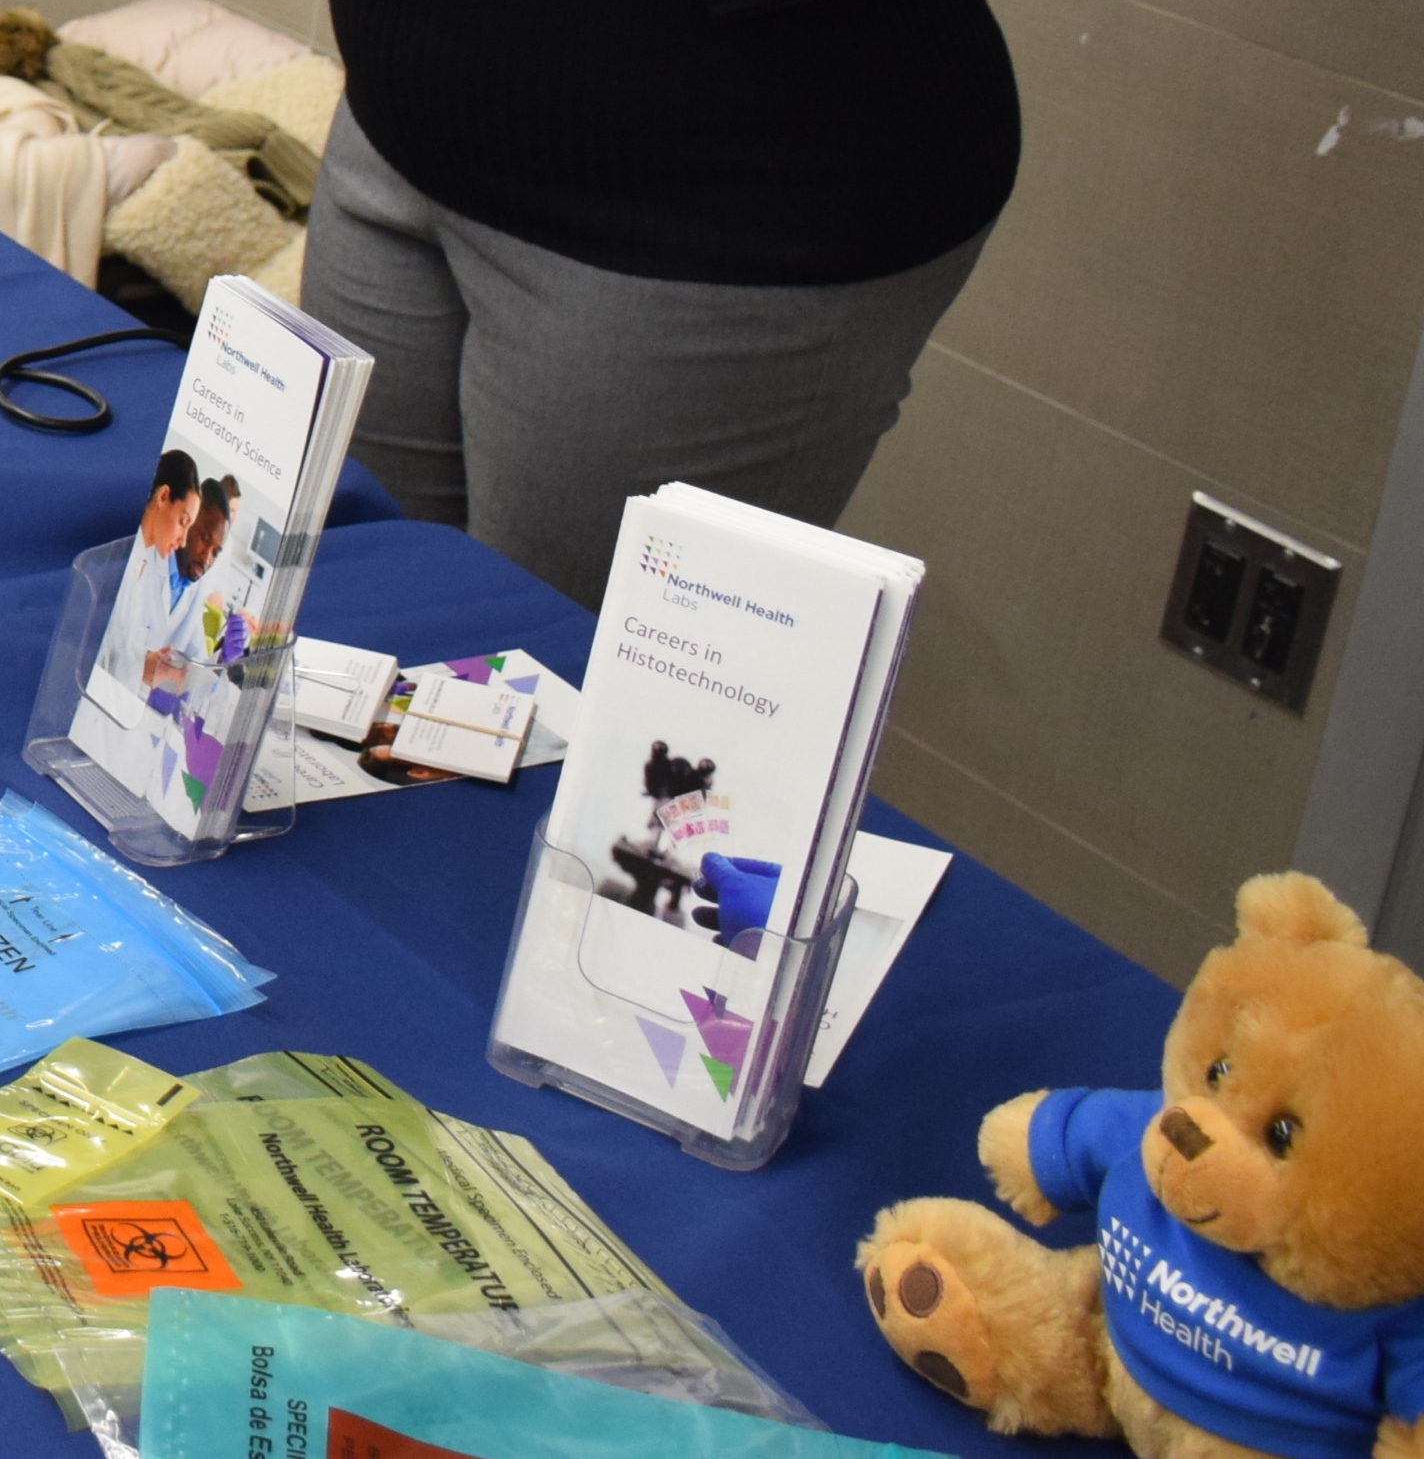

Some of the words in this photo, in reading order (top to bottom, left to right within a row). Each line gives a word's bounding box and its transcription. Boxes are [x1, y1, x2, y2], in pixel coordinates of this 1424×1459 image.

[216, 354, 236, 375] Labs
[220, 341, 260, 374] Northwell
[260, 366, 286, 393] Health
[192, 378, 232, 415] Careers
[233, 405, 245, 424] in
[186, 401, 244, 453] Laboratory
[242, 441, 282, 480] Science
[662, 588, 698, 611] Labs
[667, 573, 742, 608] Northwell
[745, 599, 795, 627] Health
[624, 616, 699, 656] Careers
[704, 643, 723, 665] in
[617, 642, 780, 717] Histotechnology
[356, 1124, 420, 1185] ROOM
[258, 1132, 319, 1202] Northwell
[305, 1200, 351, 1249] Health
[435, 1147, 471, 1191] Medical
[466, 1187, 515, 1249] Specimen
[511, 1247, 563, 1300] Enclosed
[1140, 1290, 1233, 1371] Health
[1147, 1259, 1322, 1377] Northwell
[250, 1345, 274, 1401] Bolsa
[249, 1406, 273, 1430] de
[286, 1398, 308, 1459] SPECI
